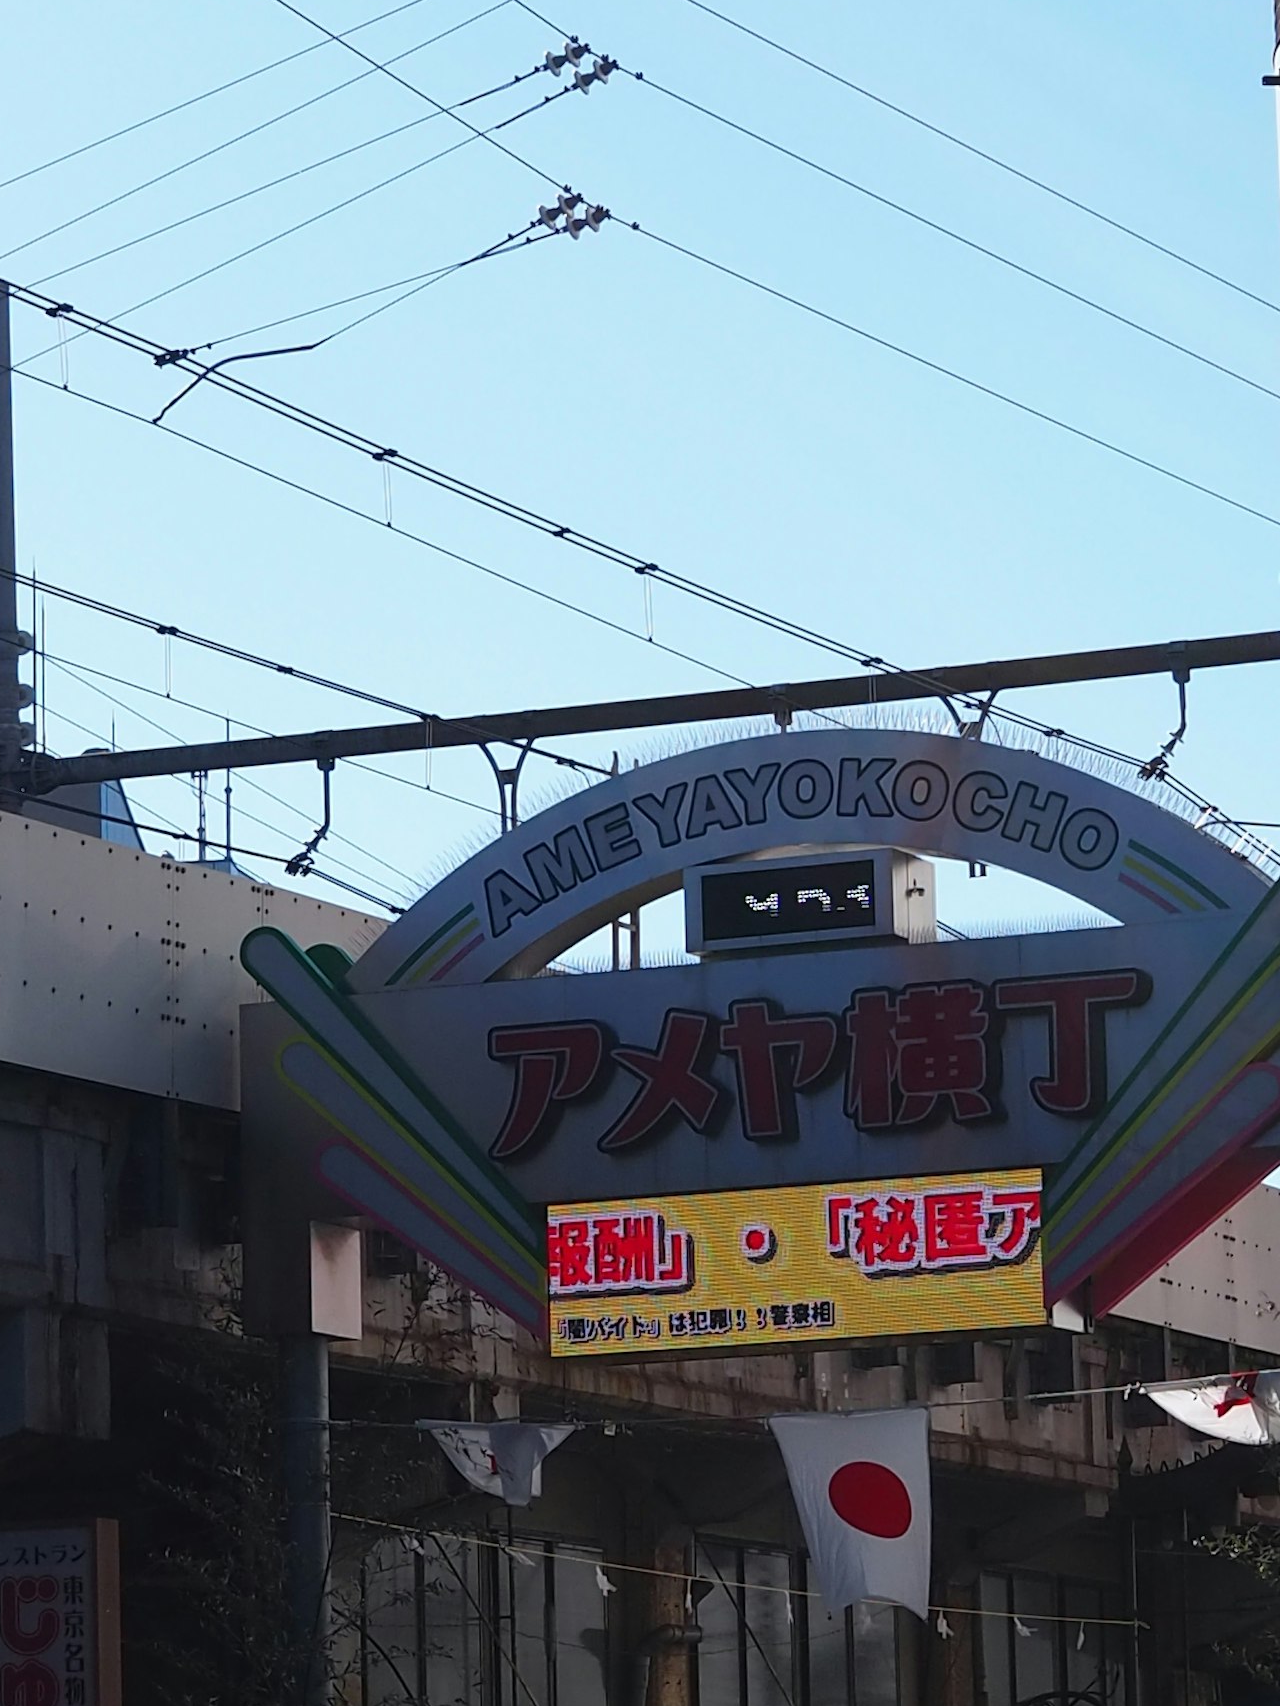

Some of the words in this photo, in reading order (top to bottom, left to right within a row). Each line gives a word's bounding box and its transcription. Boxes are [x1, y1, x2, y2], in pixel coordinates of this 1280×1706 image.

[481, 756, 1123, 939] AMEYAYOKOCHO
[485, 966, 1152, 1162] アメヤ横丁
[63, 1575, 86, 1706] 東京名物
